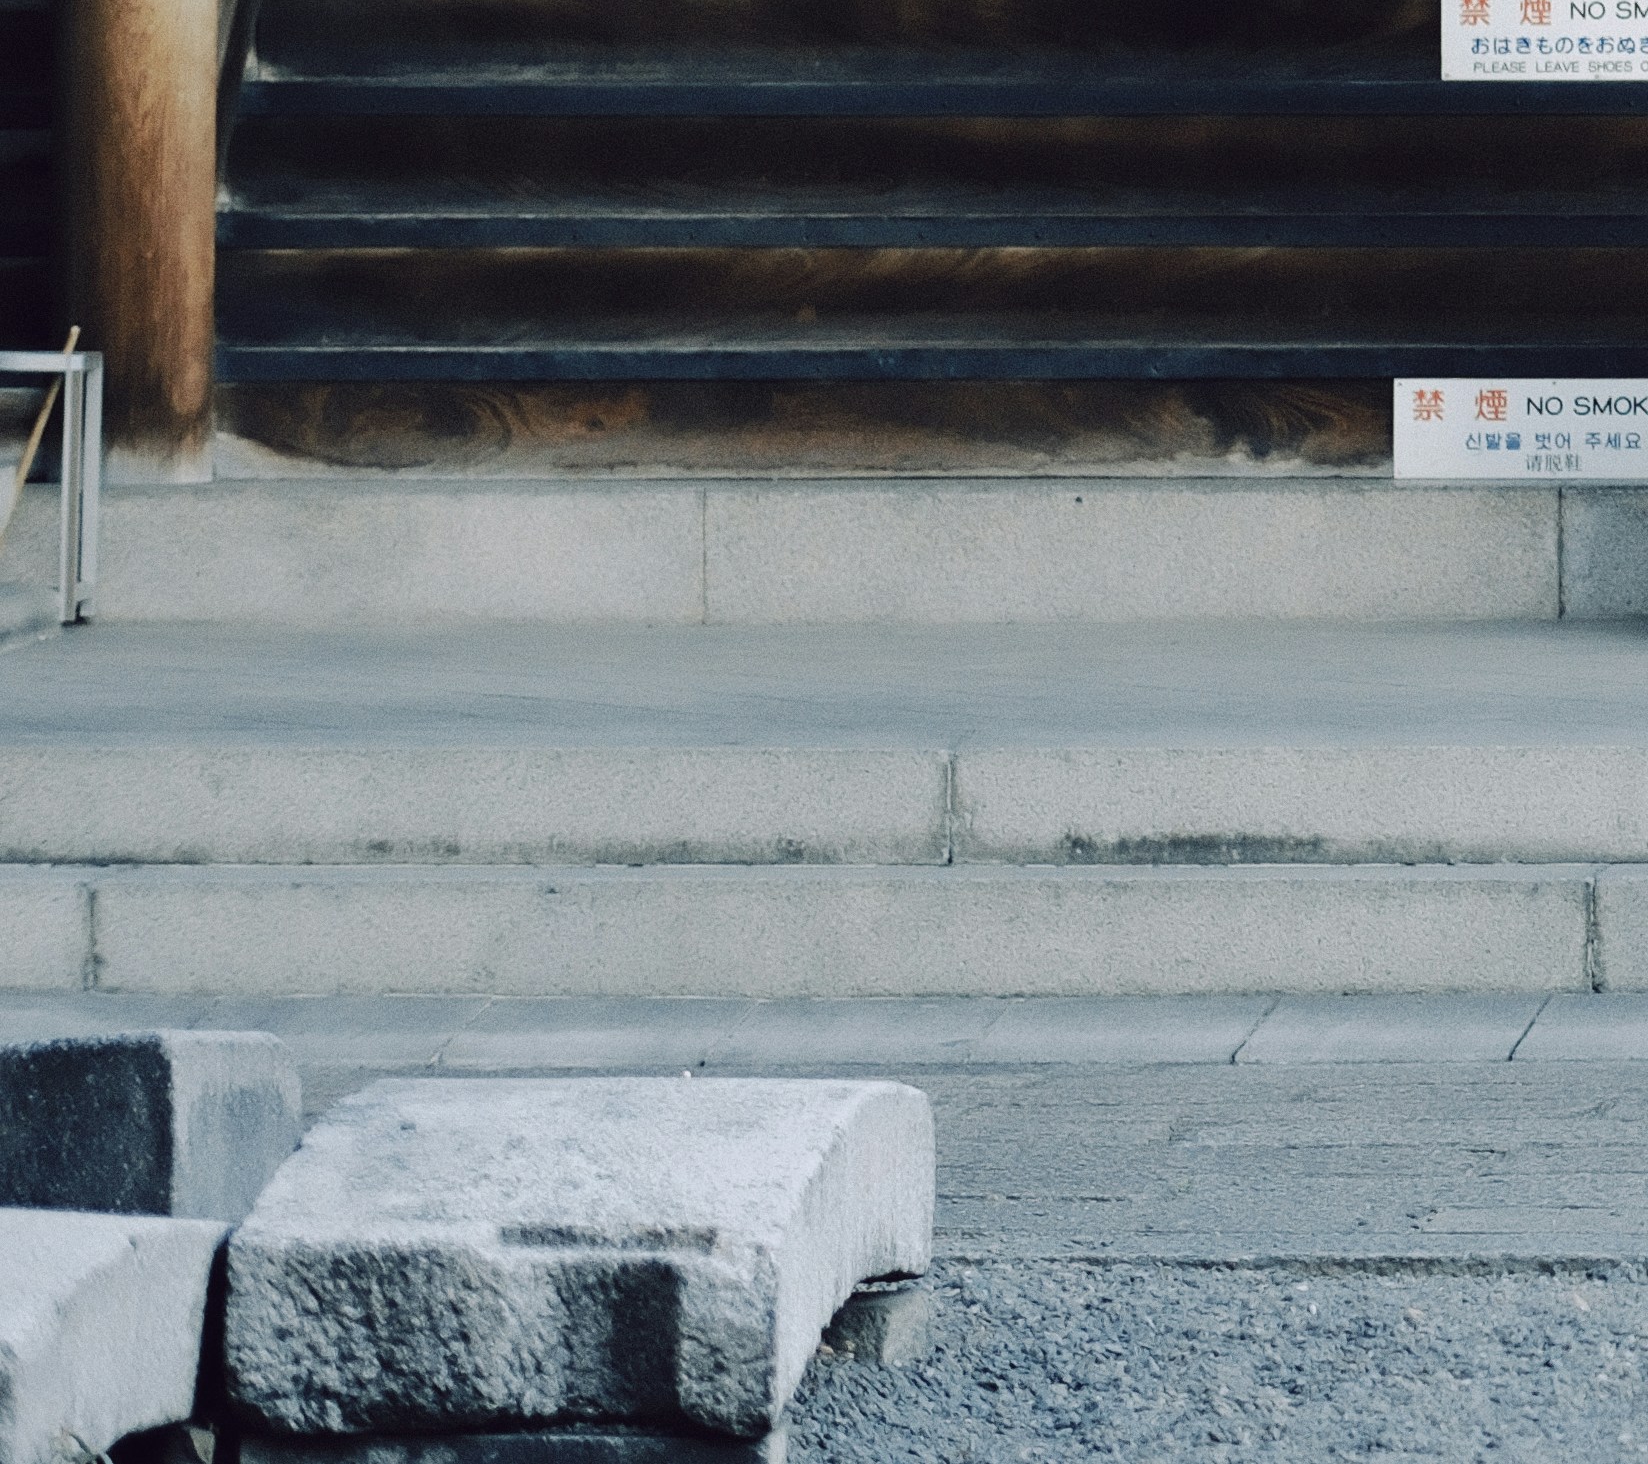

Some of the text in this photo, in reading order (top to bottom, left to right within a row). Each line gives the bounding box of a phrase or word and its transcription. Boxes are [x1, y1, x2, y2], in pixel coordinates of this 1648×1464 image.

[1569, 0, 1607, 21] NO
[1472, 61, 1526, 75] PLEASE
[1535, 60, 1580, 74] LEAVE
[1588, 60, 1633, 73] SHOES
[1526, 396, 1564, 417] NO
[1465, 431, 1642, 452] 신발을 벗어 주세요
